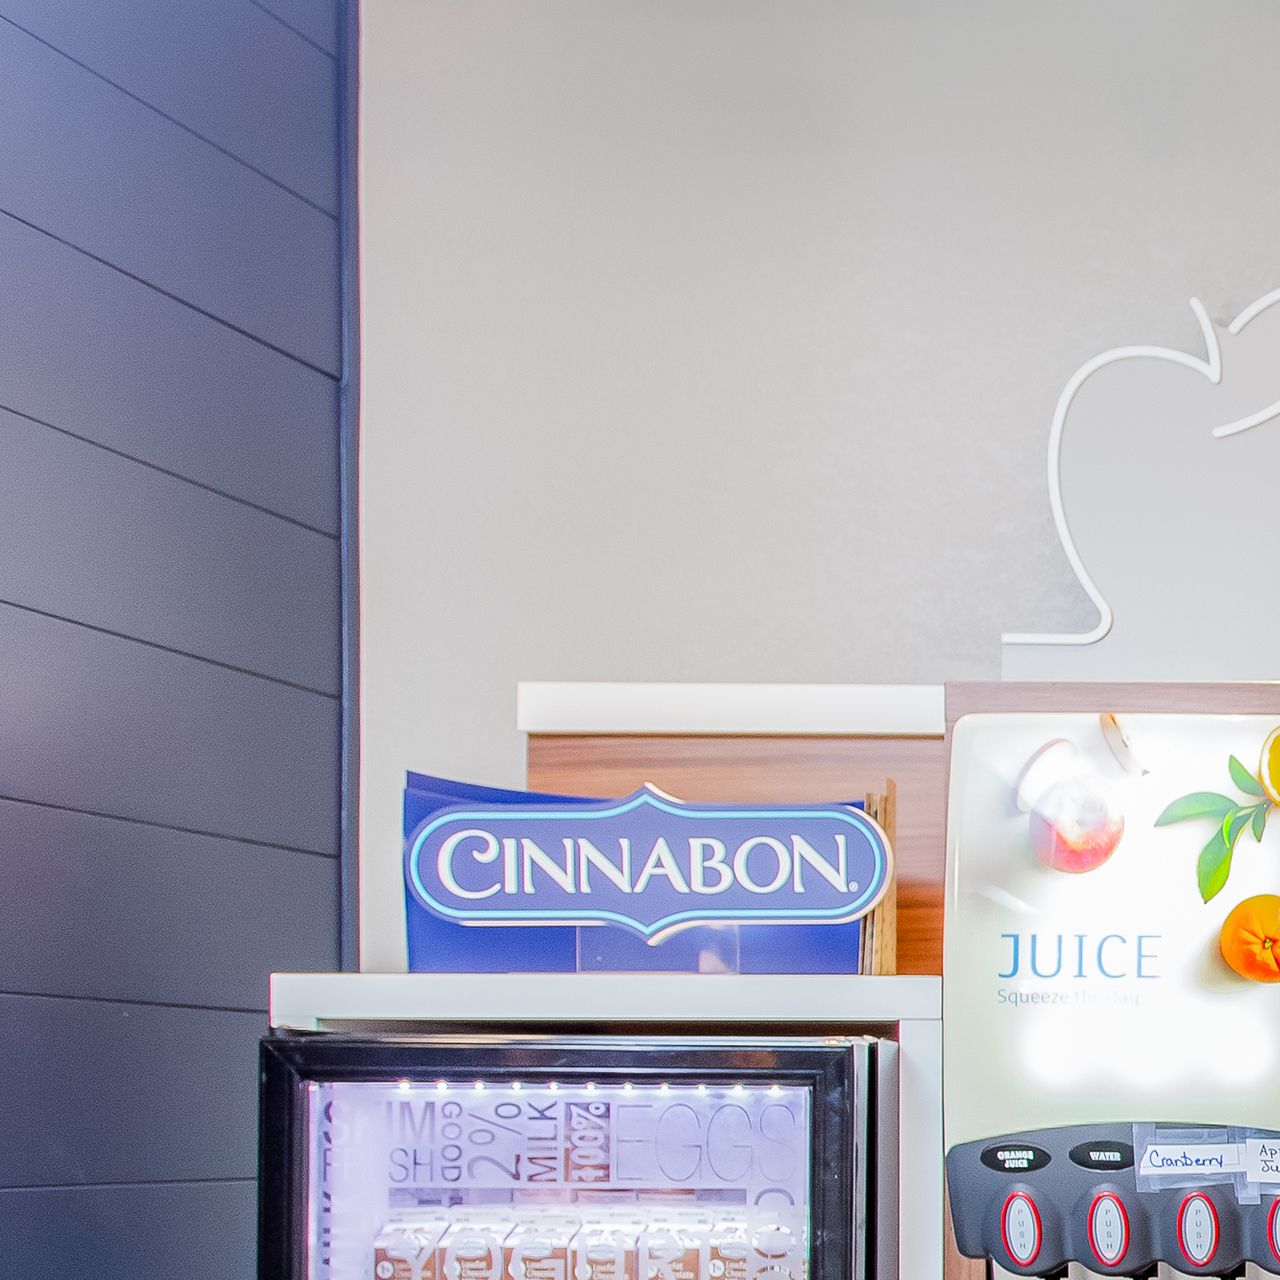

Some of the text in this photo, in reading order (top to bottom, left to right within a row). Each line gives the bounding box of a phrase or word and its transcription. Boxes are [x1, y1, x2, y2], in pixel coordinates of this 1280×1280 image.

[998, 933, 1162, 979] JUICE
[526, 1099, 559, 1183] MILK
[568, 1102, 610, 1182] 100%
[615, 1102, 797, 1183] EGGS
[1089, 1151, 1122, 1161] WATER
[1148, 1149, 1224, 1168] Cranberry
[1016, 1208, 1027, 1250] PUSH
[1104, 1208, 1114, 1250] PUSH
[1194, 1208, 1203, 1250] PUSH
